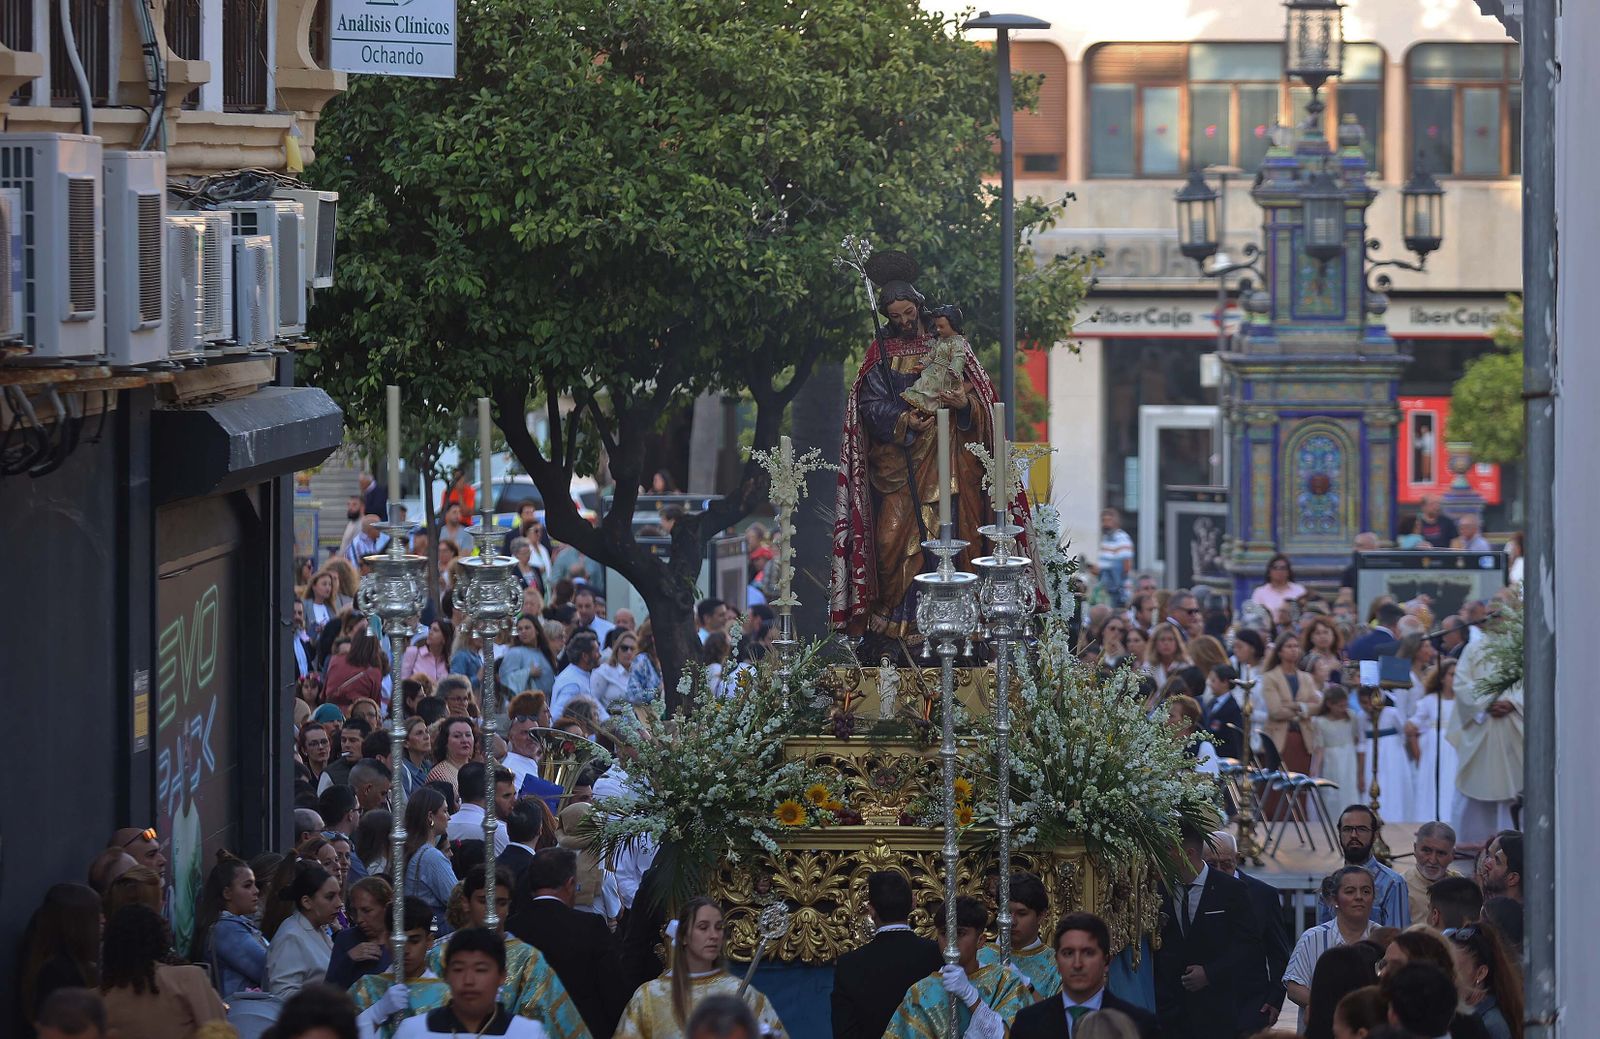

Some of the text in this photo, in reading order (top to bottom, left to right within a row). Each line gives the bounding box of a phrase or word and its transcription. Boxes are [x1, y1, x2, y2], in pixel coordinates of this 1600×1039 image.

[337, 13, 449, 35] Análisis Clínicos
[361, 45, 424, 65] Ochando
[159, 584, 219, 731] EVO
